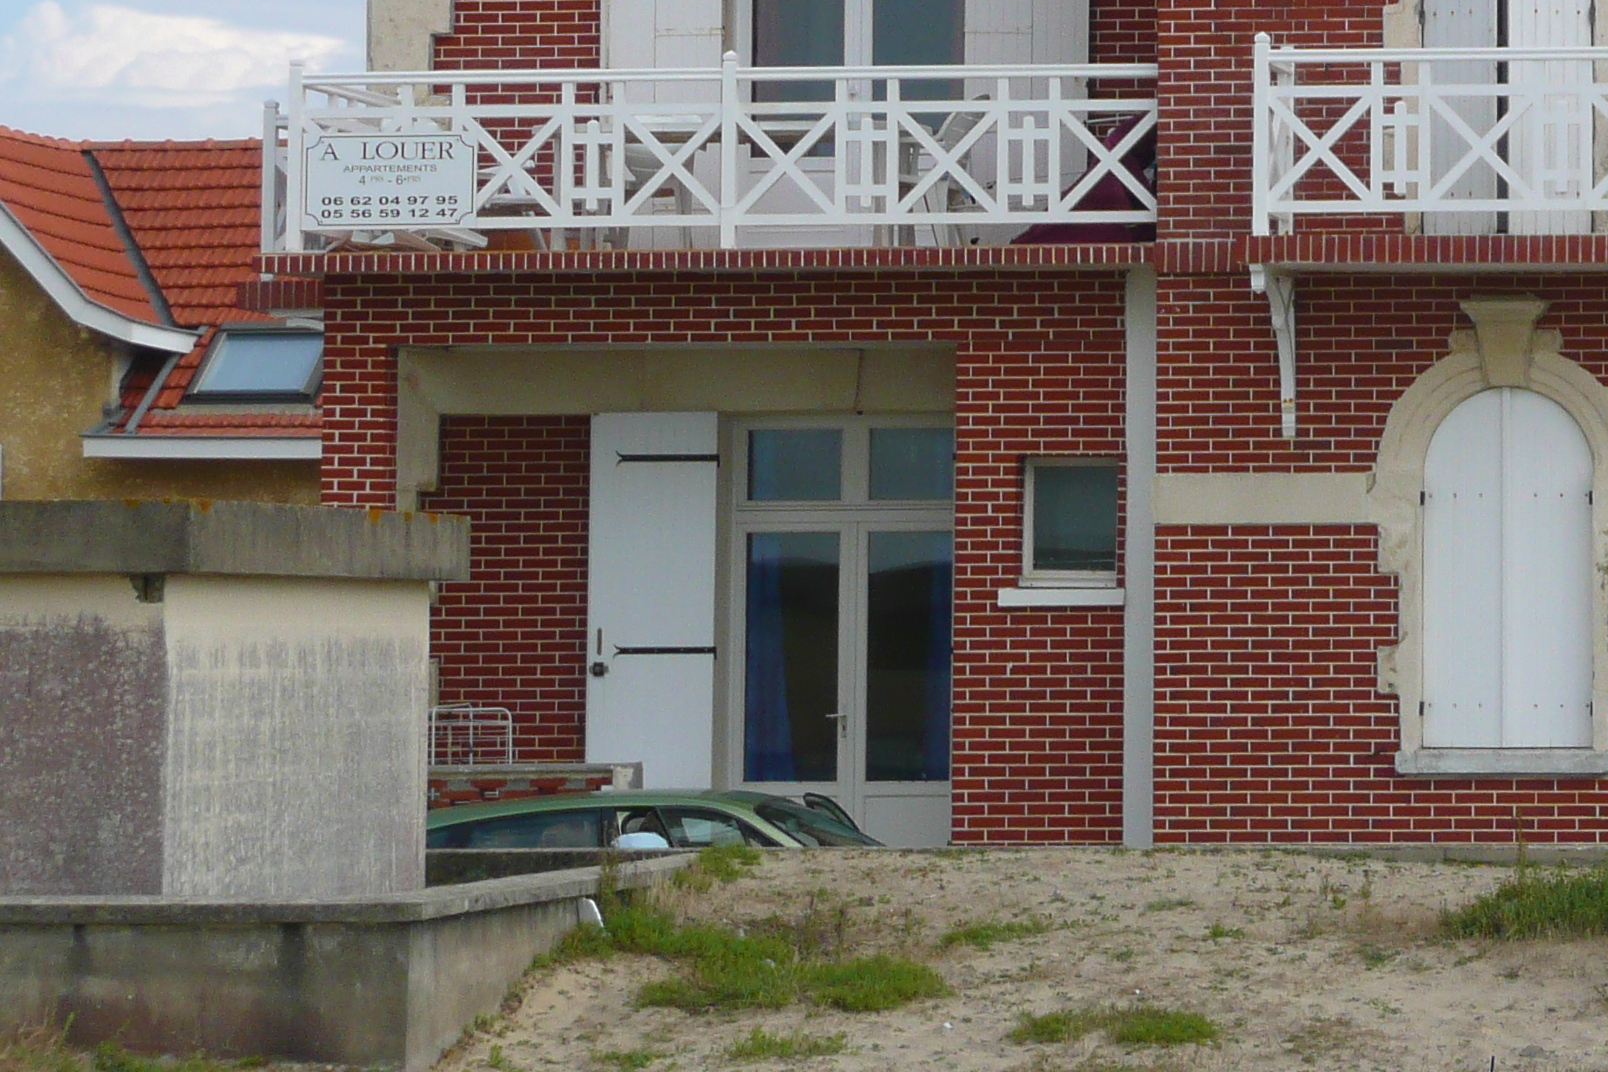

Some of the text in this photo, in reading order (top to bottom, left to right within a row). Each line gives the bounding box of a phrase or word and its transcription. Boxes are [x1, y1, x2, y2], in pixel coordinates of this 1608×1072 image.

[319, 141, 454, 160] A LOUER
[343, 164, 437, 173] APPARTEMENTS
[322, 195, 458, 206] 06 62 04 97 95
[321, 208, 458, 218] 05 56 59 12 47
